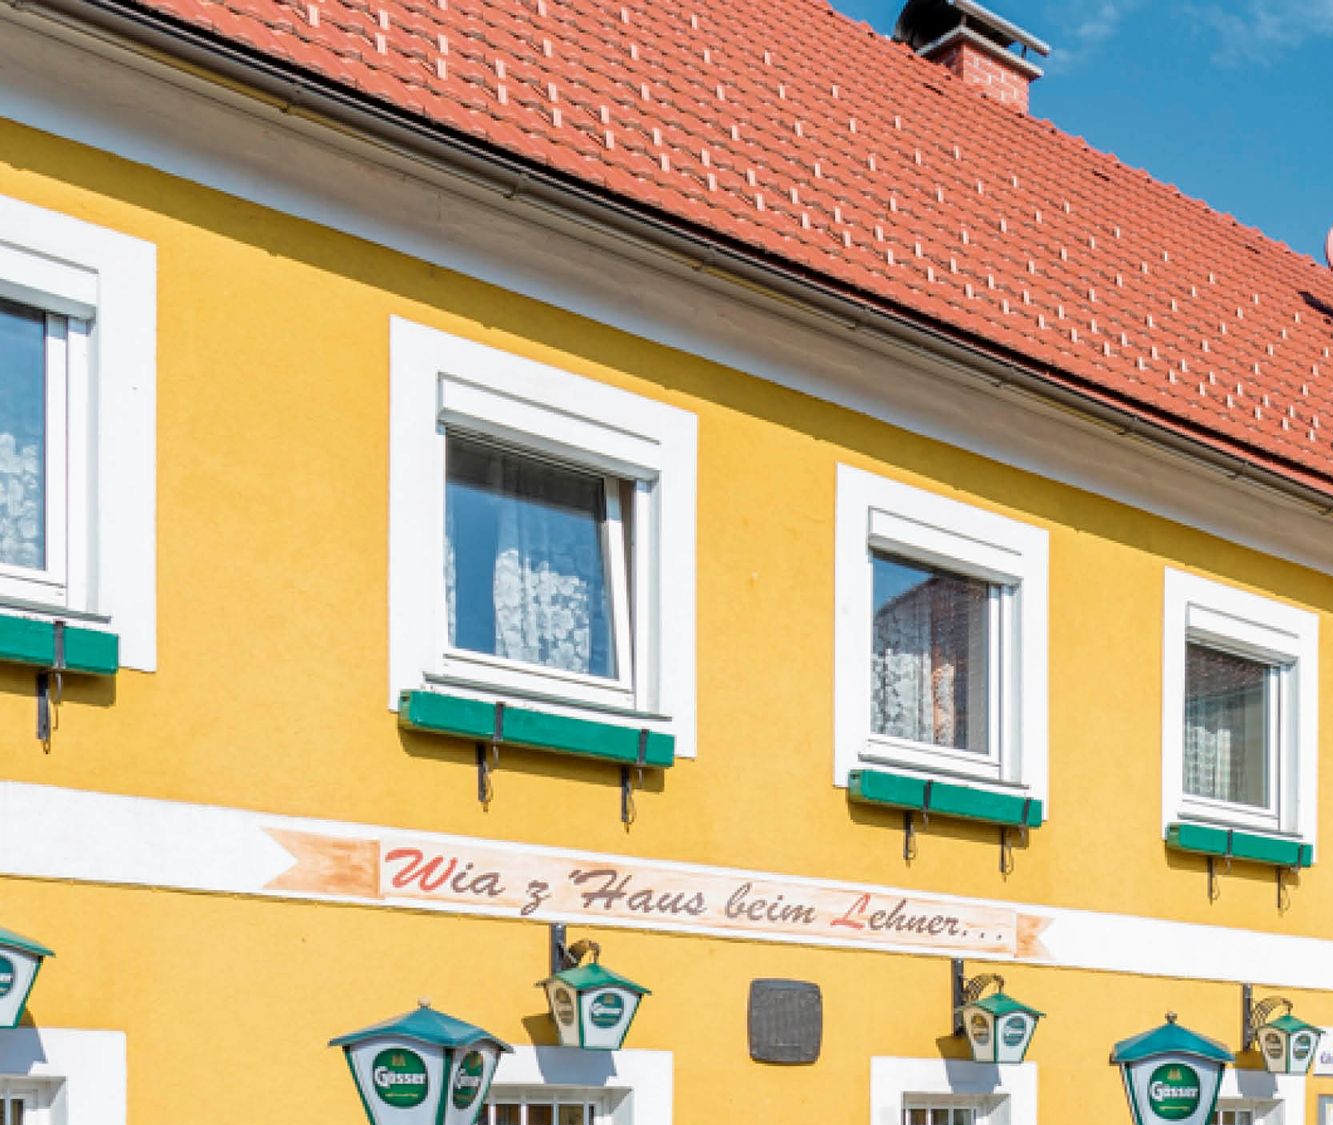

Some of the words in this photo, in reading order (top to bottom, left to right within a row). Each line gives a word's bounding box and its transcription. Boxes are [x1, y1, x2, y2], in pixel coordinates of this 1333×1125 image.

[384, 847, 506, 897] Wia
[519, 879, 553, 916] z
[724, 882, 817, 924] beim
